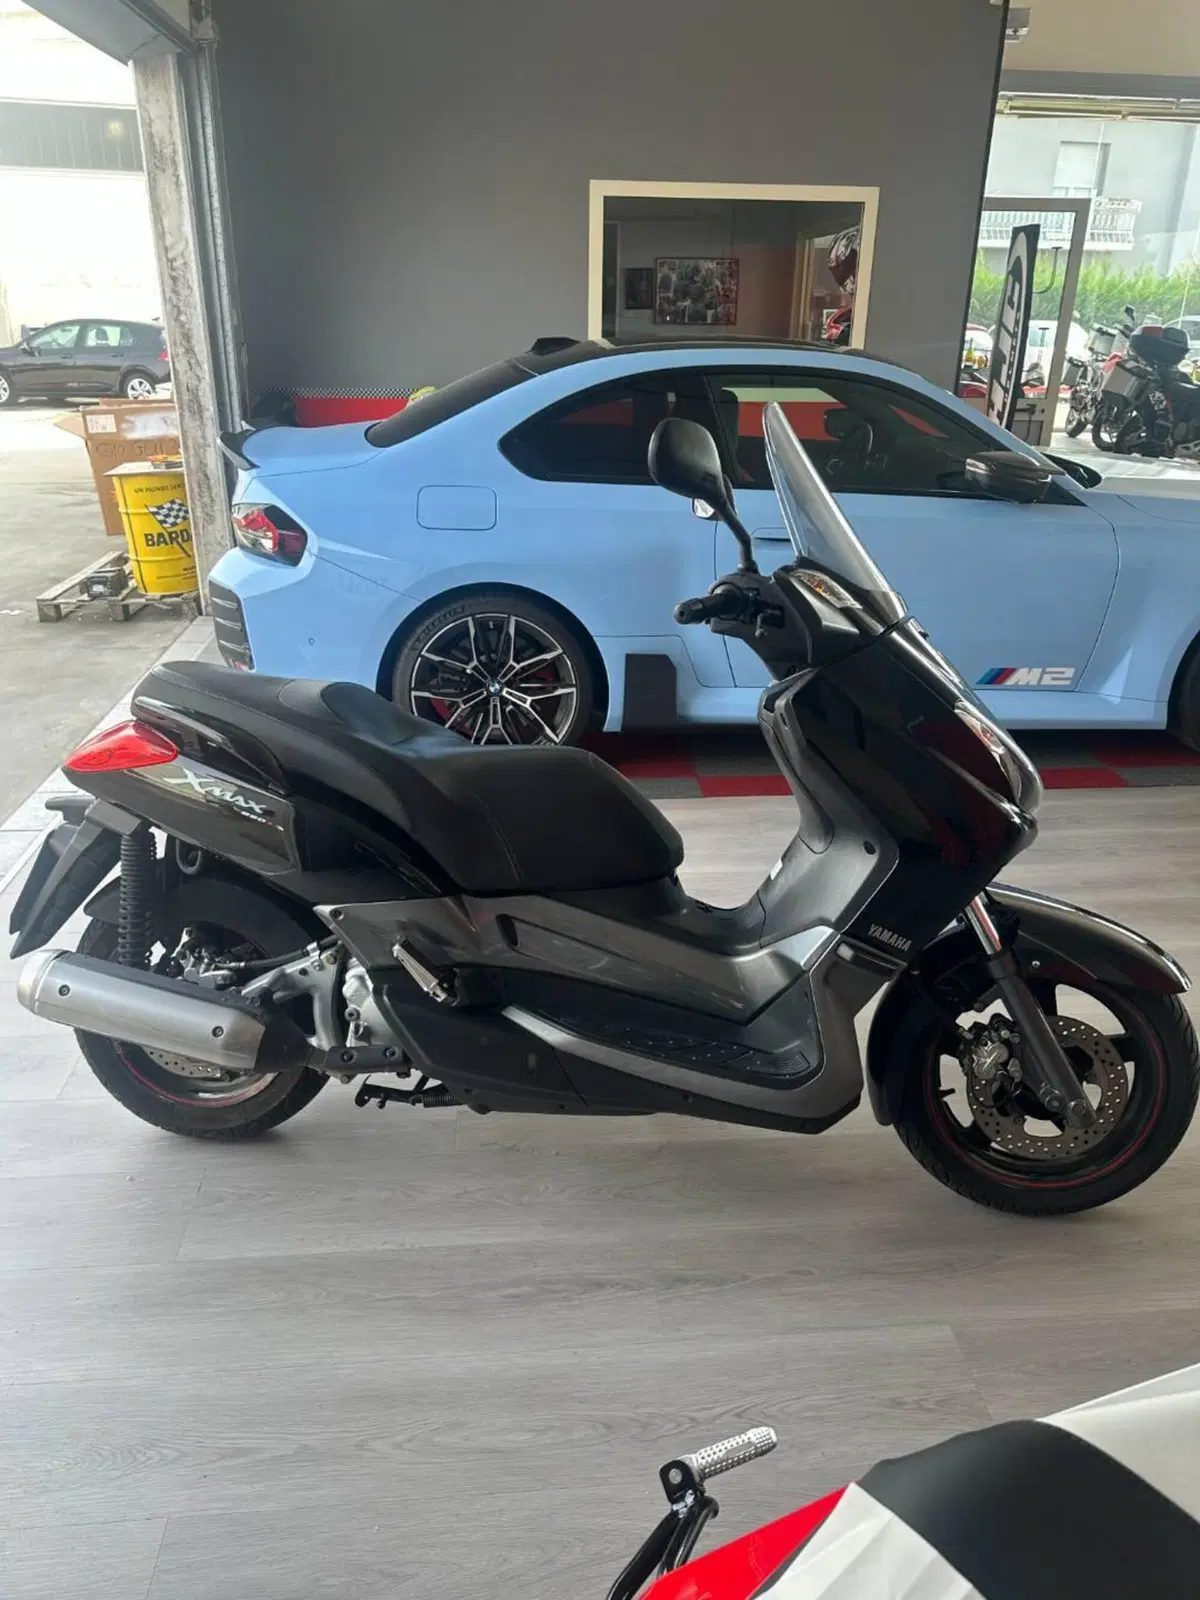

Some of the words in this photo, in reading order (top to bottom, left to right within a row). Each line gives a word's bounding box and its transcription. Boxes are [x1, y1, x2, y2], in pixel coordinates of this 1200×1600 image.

[144, 528, 193, 547] BARD
[1004, 667, 1075, 685] M2
[868, 924, 912, 952] YAMAHA
